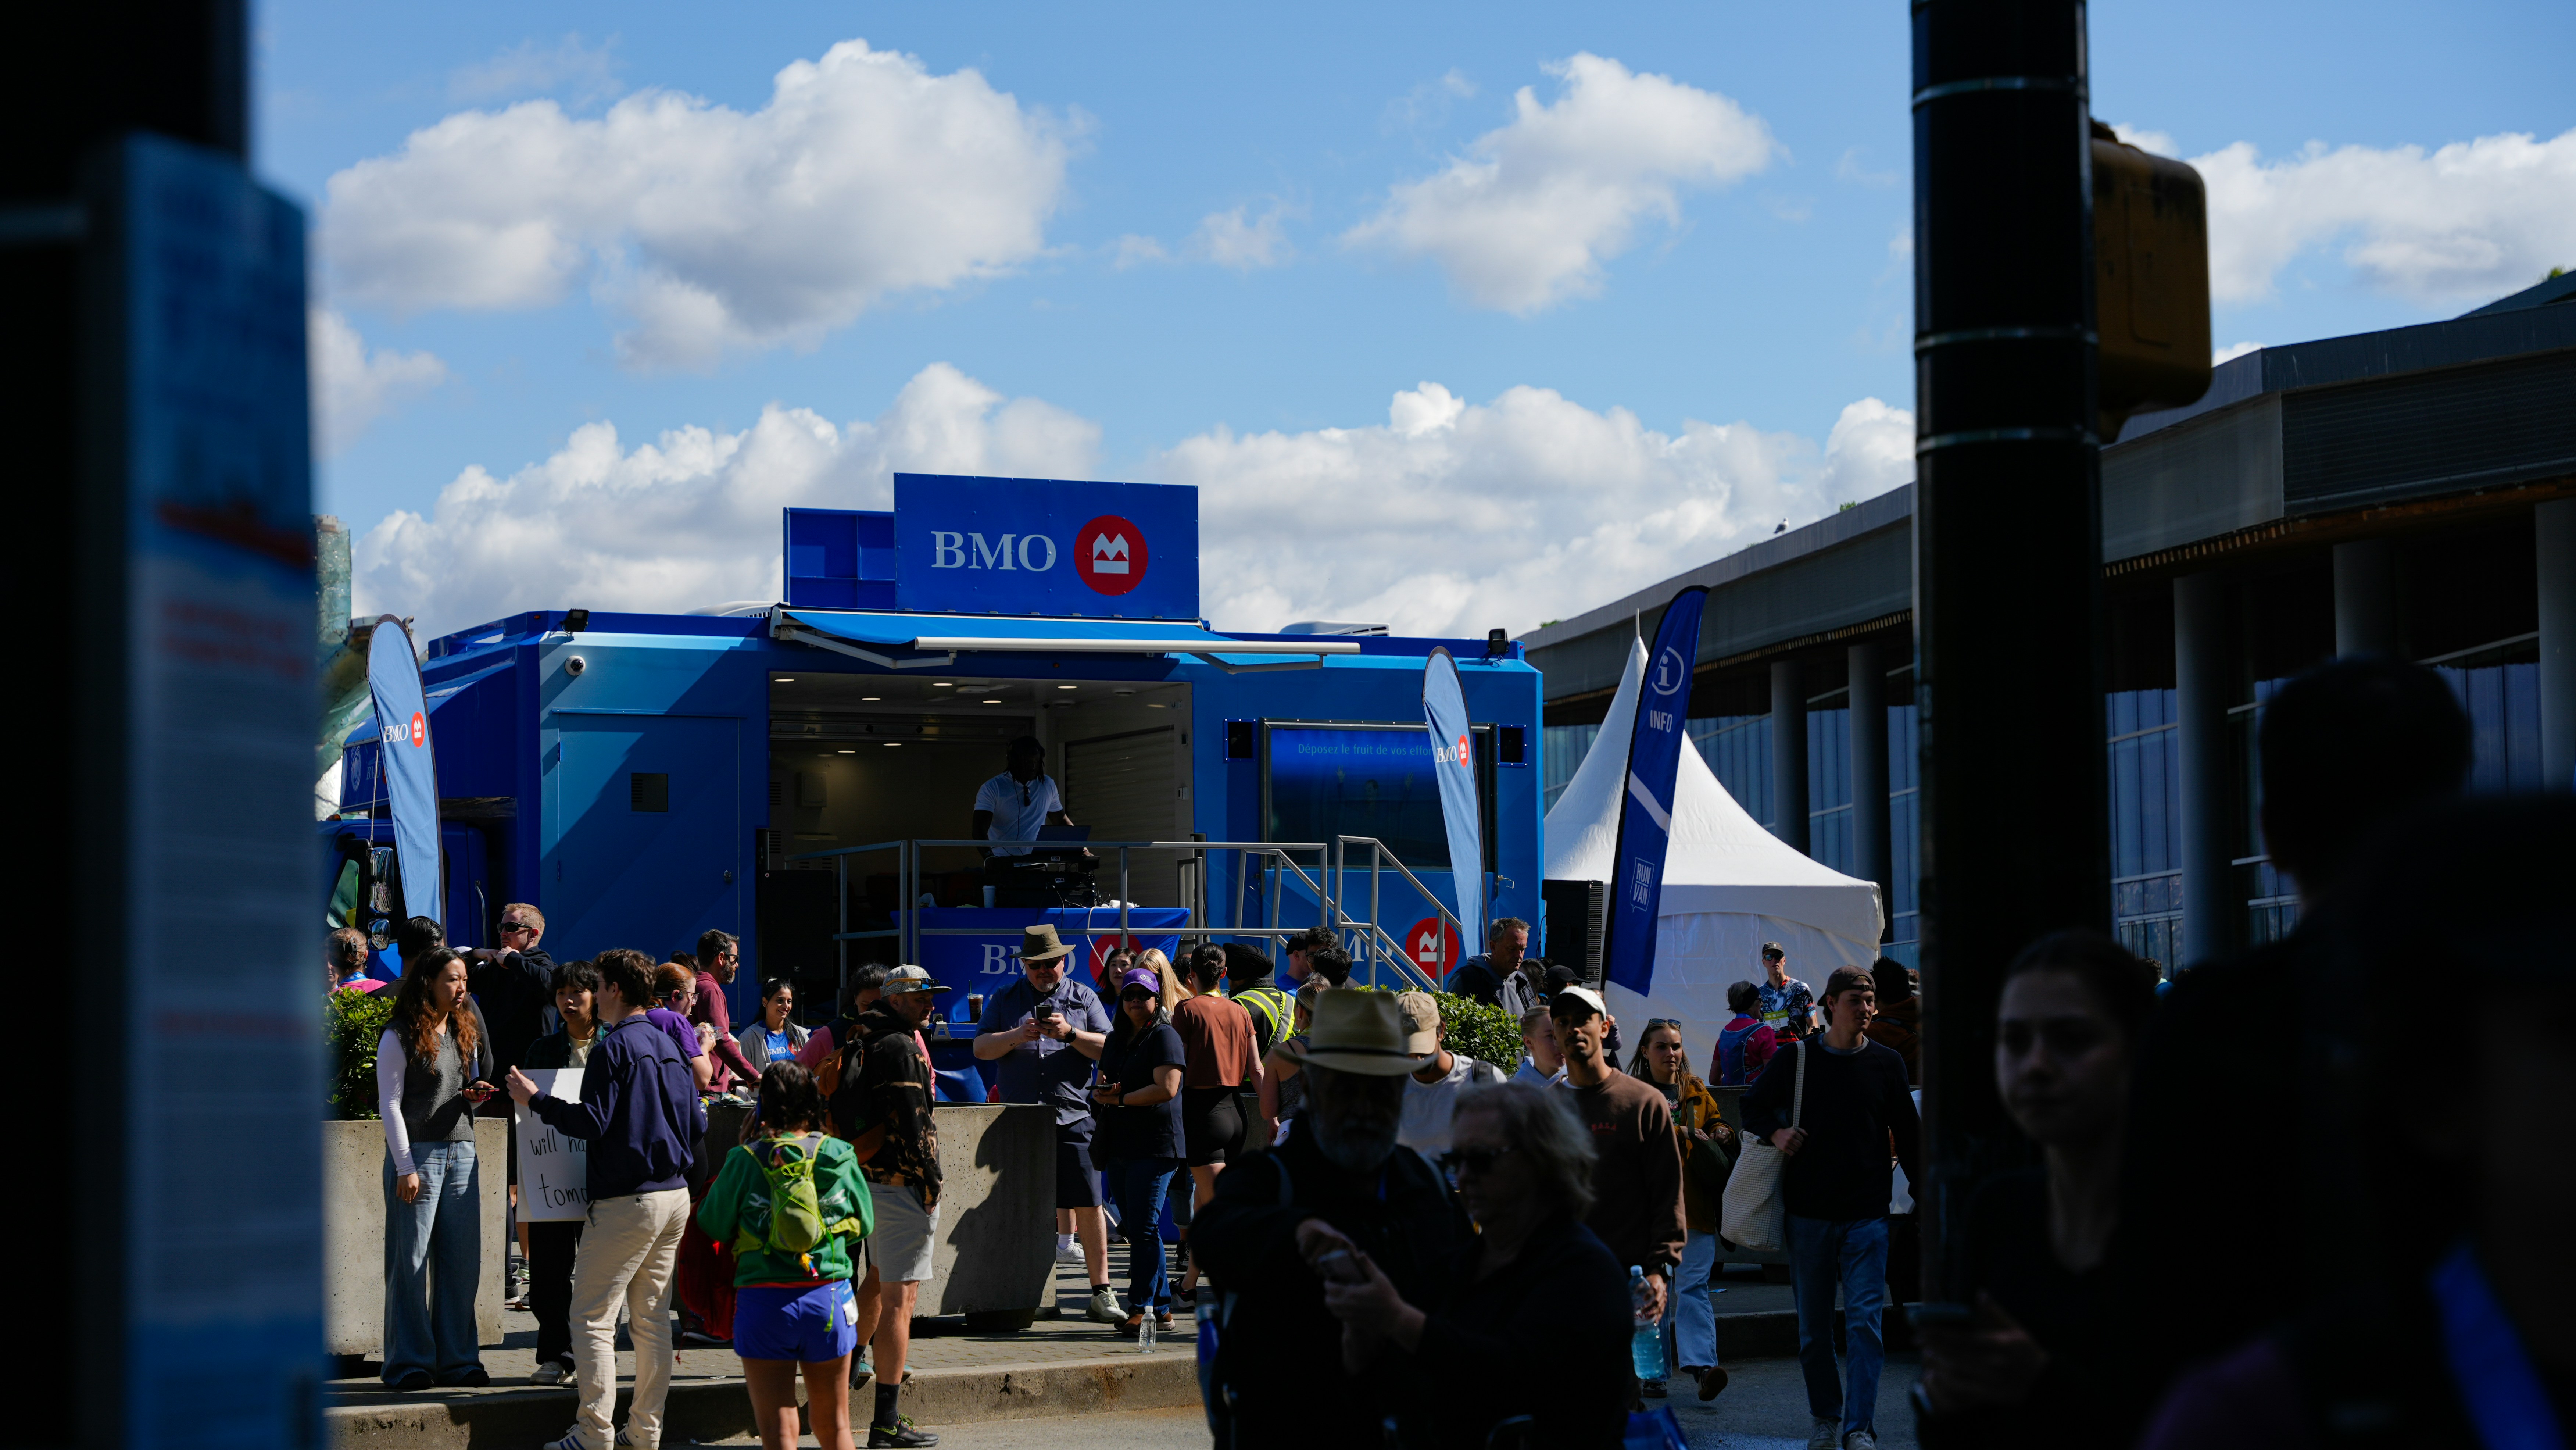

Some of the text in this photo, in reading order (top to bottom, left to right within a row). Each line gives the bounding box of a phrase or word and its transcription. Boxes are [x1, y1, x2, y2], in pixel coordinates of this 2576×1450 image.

[931, 531, 1056, 571] BMO
[1650, 709, 1673, 733] INFO
[383, 723, 409, 743] BMO
[1298, 743, 1338, 756] Déposez
[1342, 744, 1350, 754] le
[1354, 744, 1373, 755] fruit
[1376, 744, 1388, 755] de
[1392, 747, 1406, 756] vos
[1436, 745, 1457, 764] BMO
[366, 764, 381, 780] BMO
[1636, 863, 1652, 885] RUN
[1633, 883, 1648, 906] VAN
[530, 1128, 558, 1156] will
